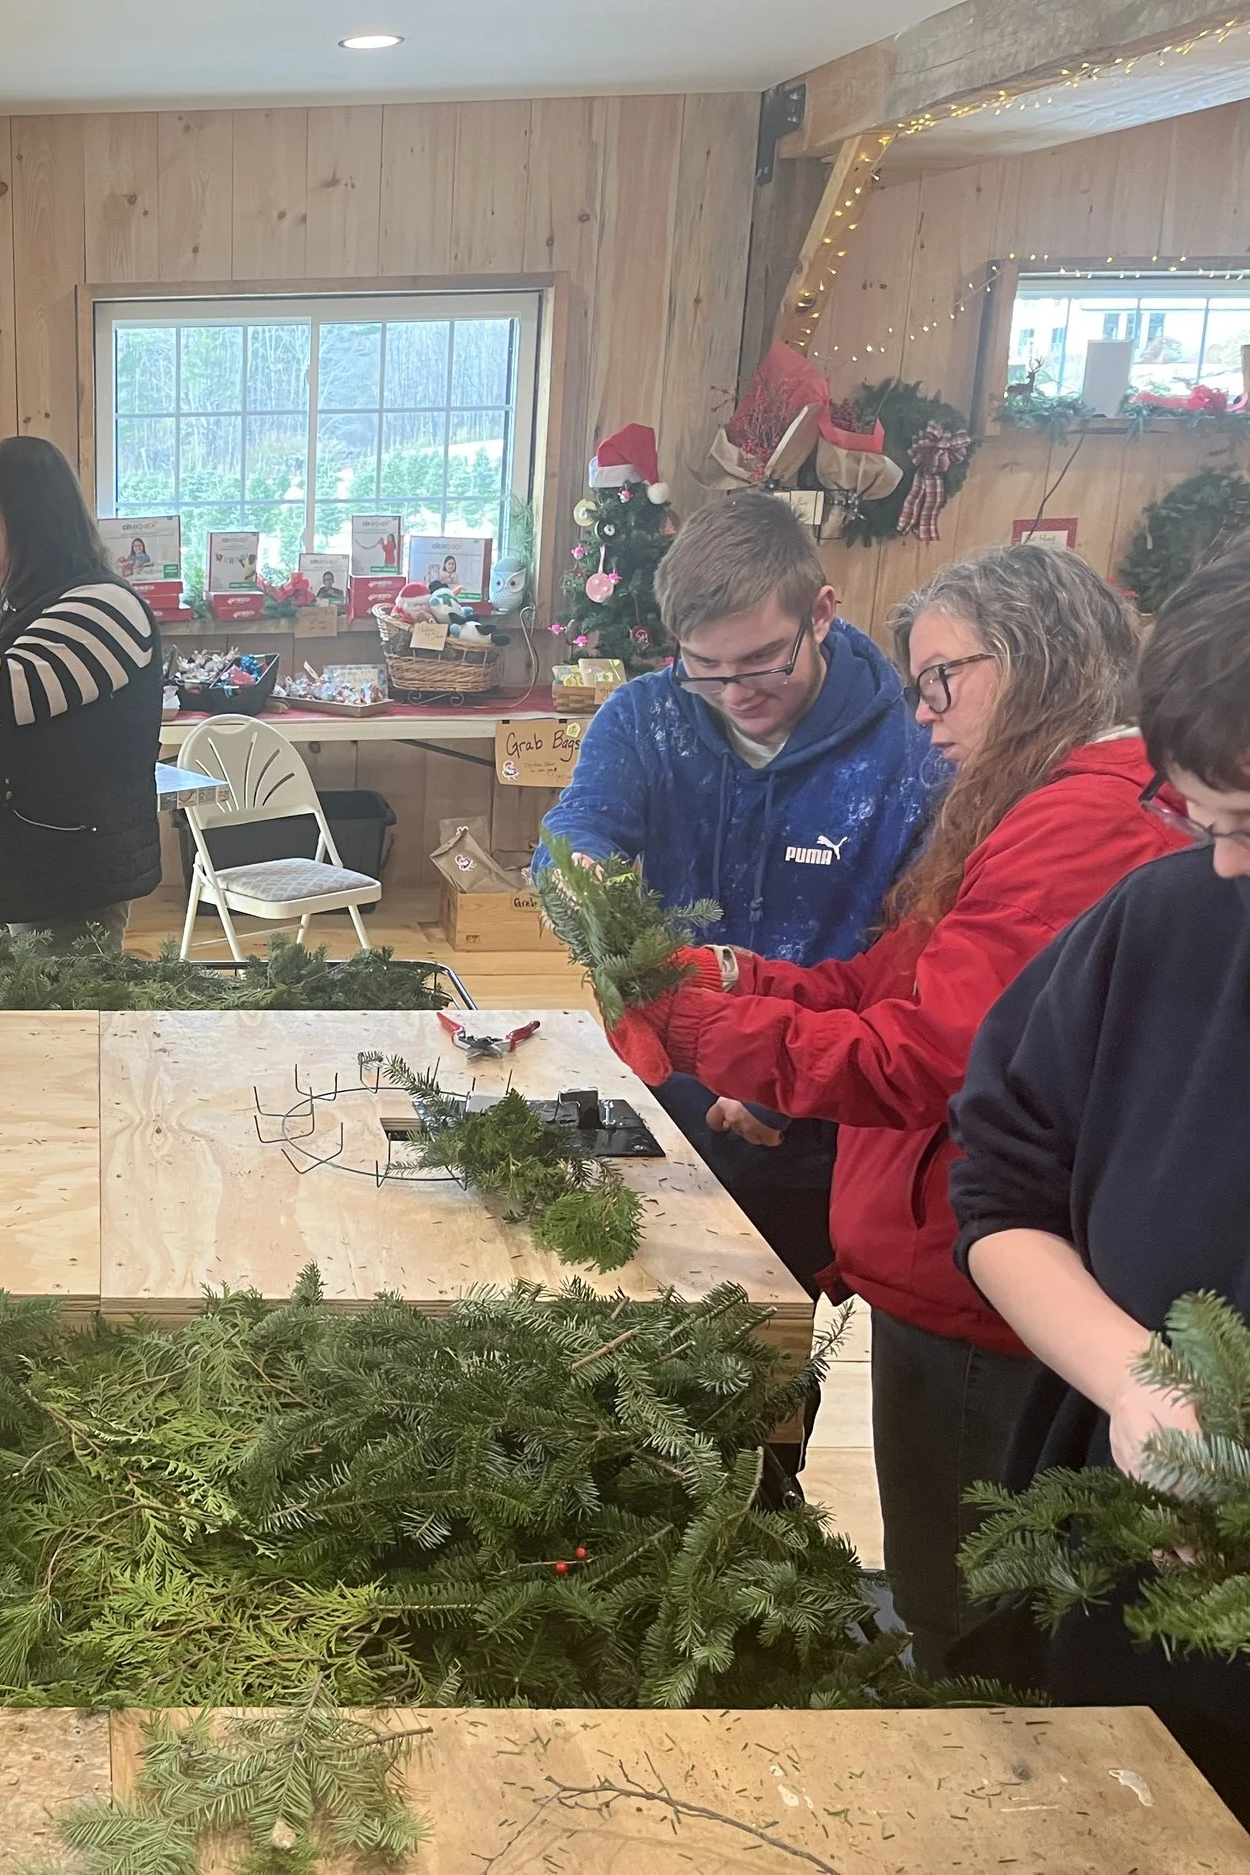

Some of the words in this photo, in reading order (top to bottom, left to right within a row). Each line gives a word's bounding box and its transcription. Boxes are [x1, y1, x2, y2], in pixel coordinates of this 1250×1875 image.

[506, 732, 543, 759] Grab
[552, 729, 581, 763] Bags
[785, 846, 833, 866] PUMA
